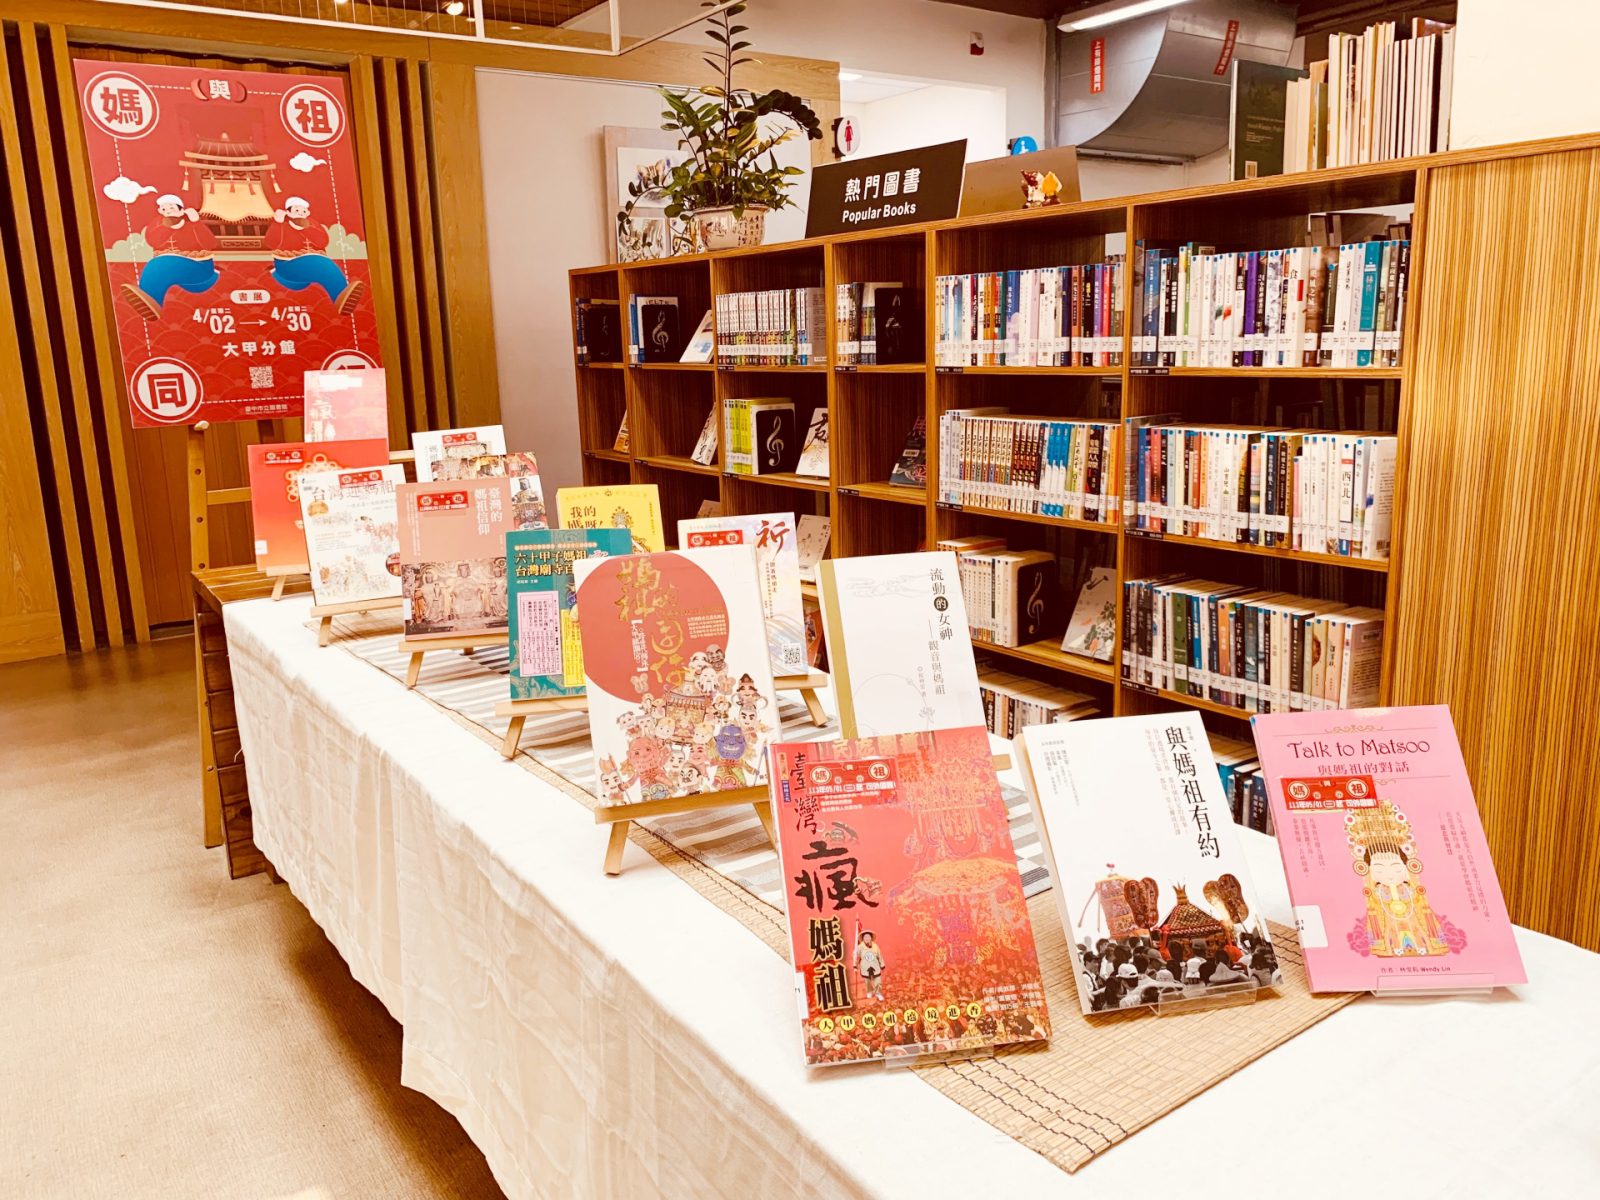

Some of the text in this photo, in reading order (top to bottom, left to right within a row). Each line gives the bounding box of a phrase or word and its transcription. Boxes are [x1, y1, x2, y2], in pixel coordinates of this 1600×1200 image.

[100, 87, 144, 126] 媽
[208, 79, 231, 100] 與
[294, 98, 333, 134] 祖
[844, 167, 921, 203] 熱門圖書
[842, 202, 916, 223] Popular Books
[222, 340, 296, 357] 大甲分館
[147, 372, 189, 410] 同
[570, 505, 596, 518] 我的
[756, 520, 790, 560] 祈
[930, 568, 953, 641] 流動的女神
[1287, 739, 1430, 758] Talk to Matsoo
[1318, 761, 1409, 775] 與媽祖的對話
[1165, 726, 1220, 859] 與媽祖有約
